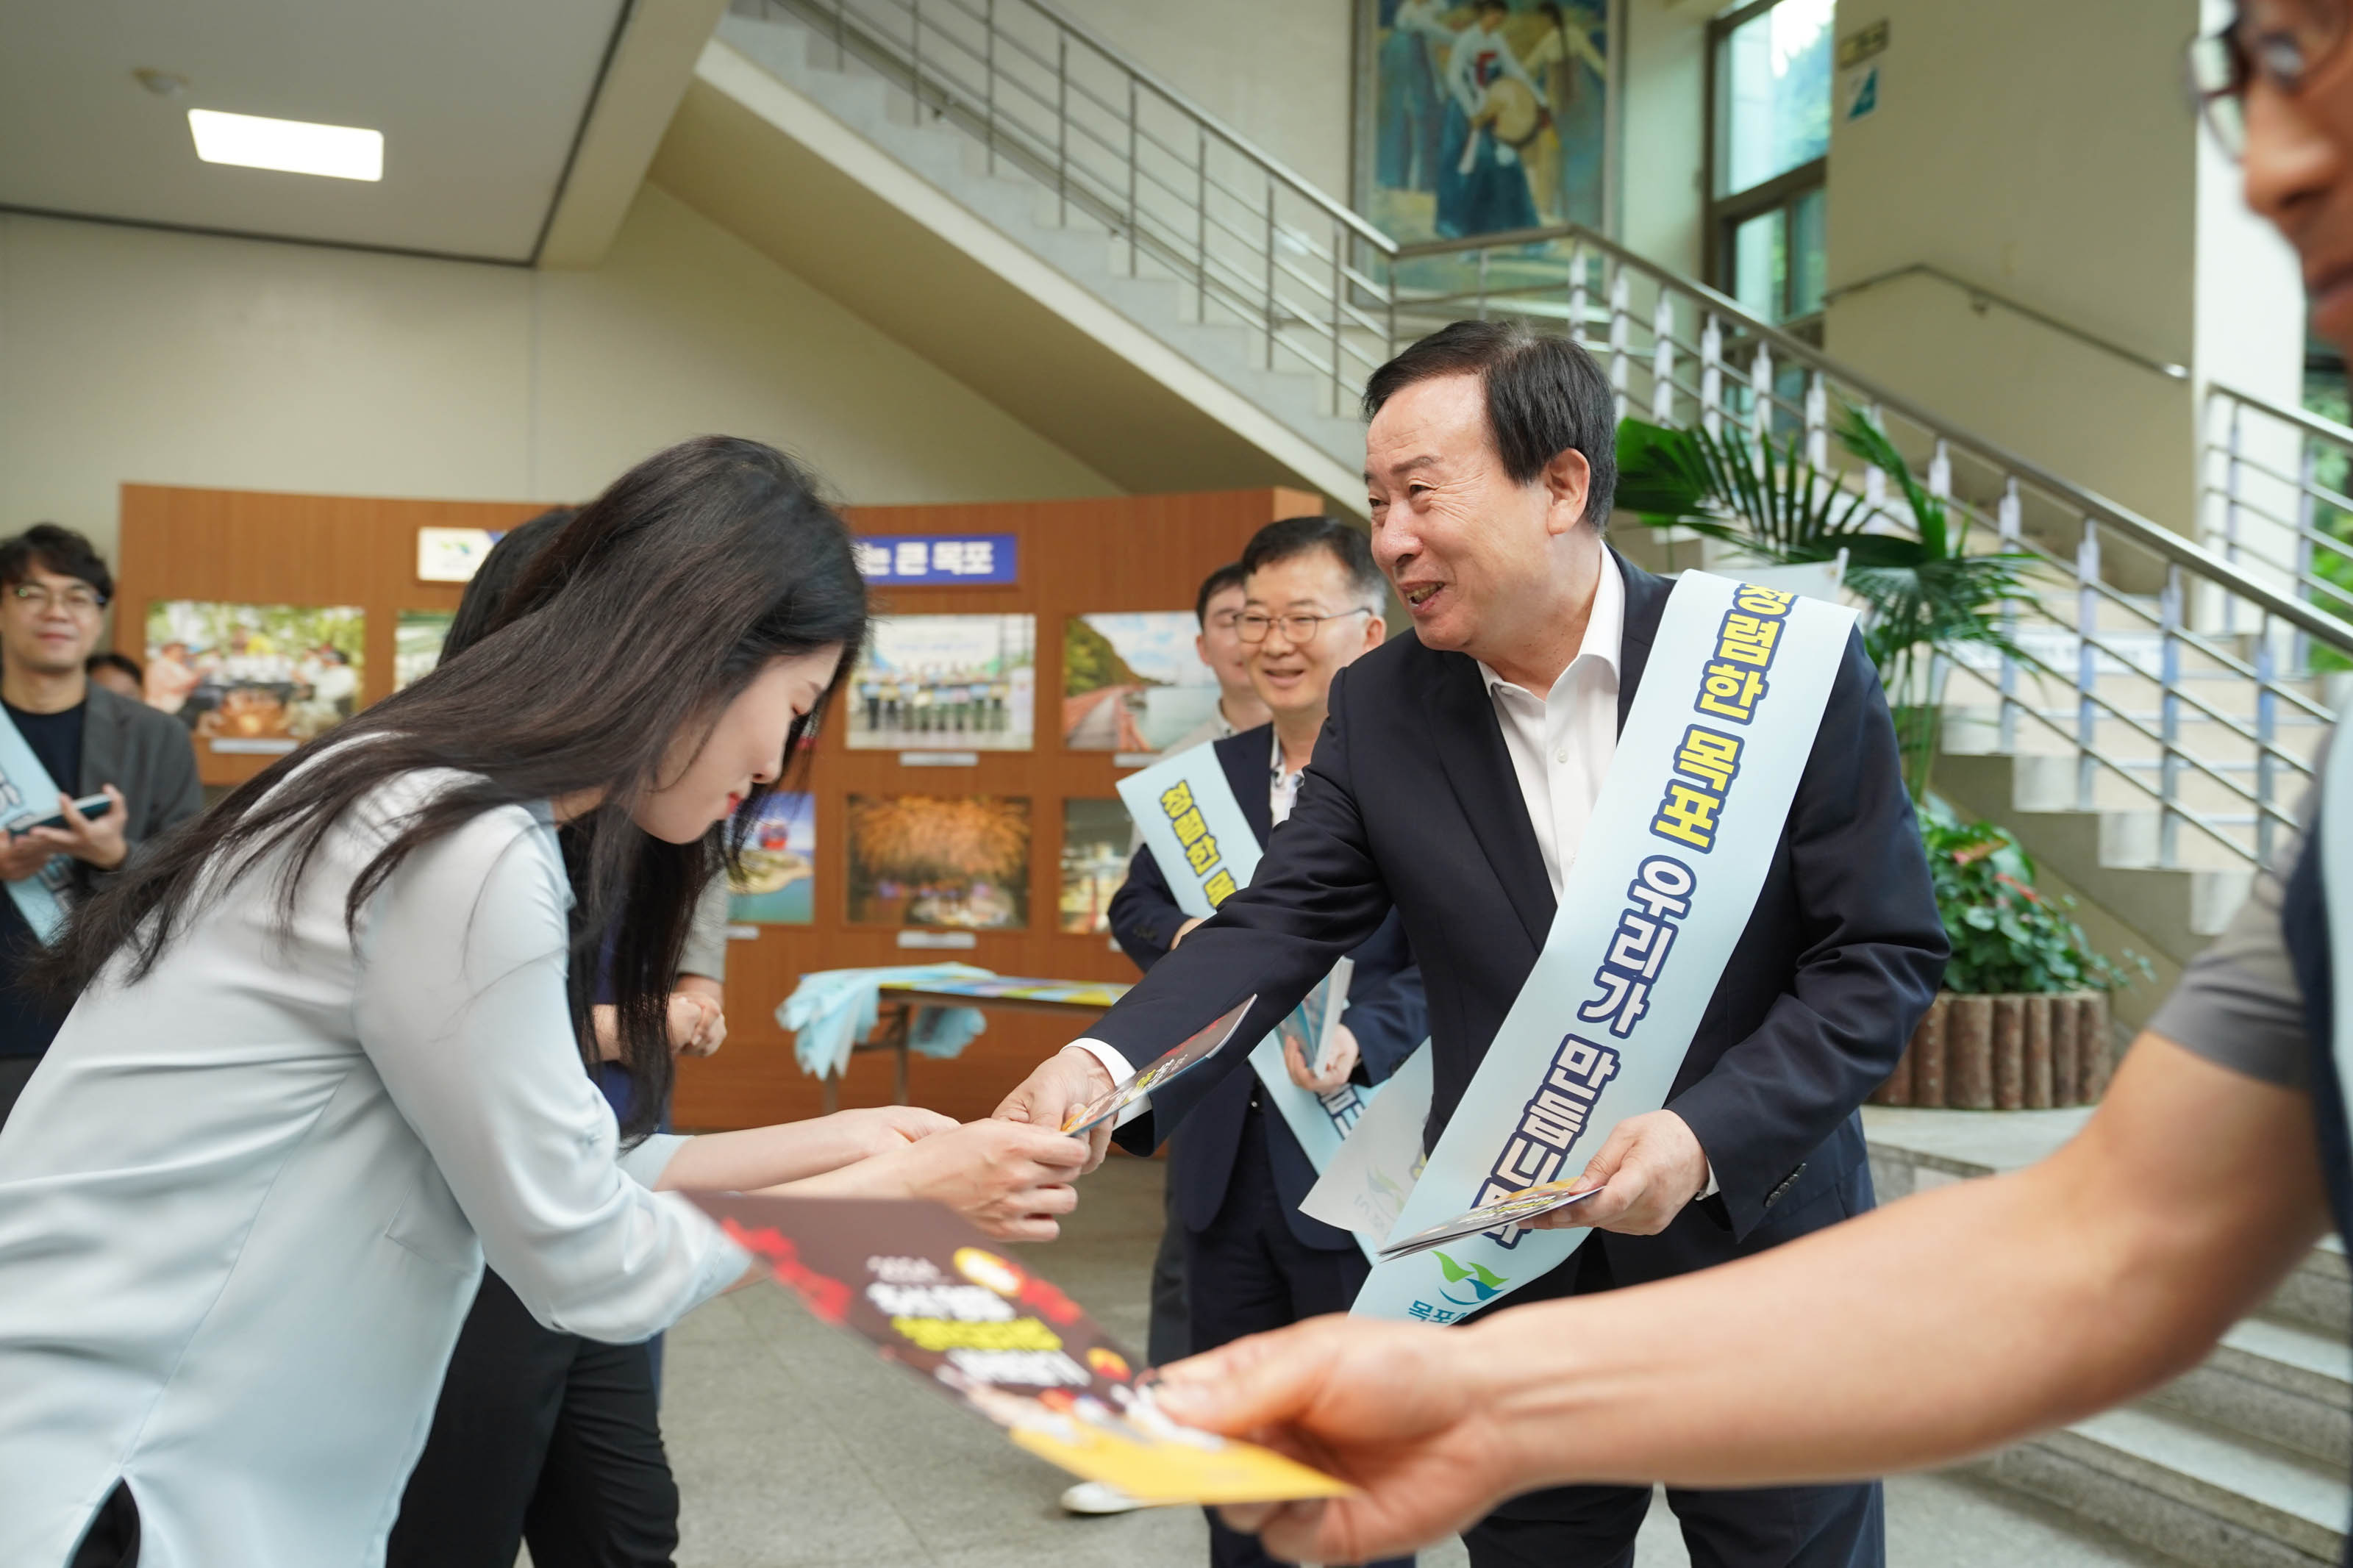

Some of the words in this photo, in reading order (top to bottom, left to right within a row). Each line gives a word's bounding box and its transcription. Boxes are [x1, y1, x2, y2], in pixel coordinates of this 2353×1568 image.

[895, 540, 929, 576] 큰
[932, 540, 995, 576] 목포
[1694, 583, 1800, 725] 청렴한
[1160, 778, 1221, 877] 청렴한
[1649, 724, 1745, 854] 목포
[1577, 855, 1697, 1039] 우리가
